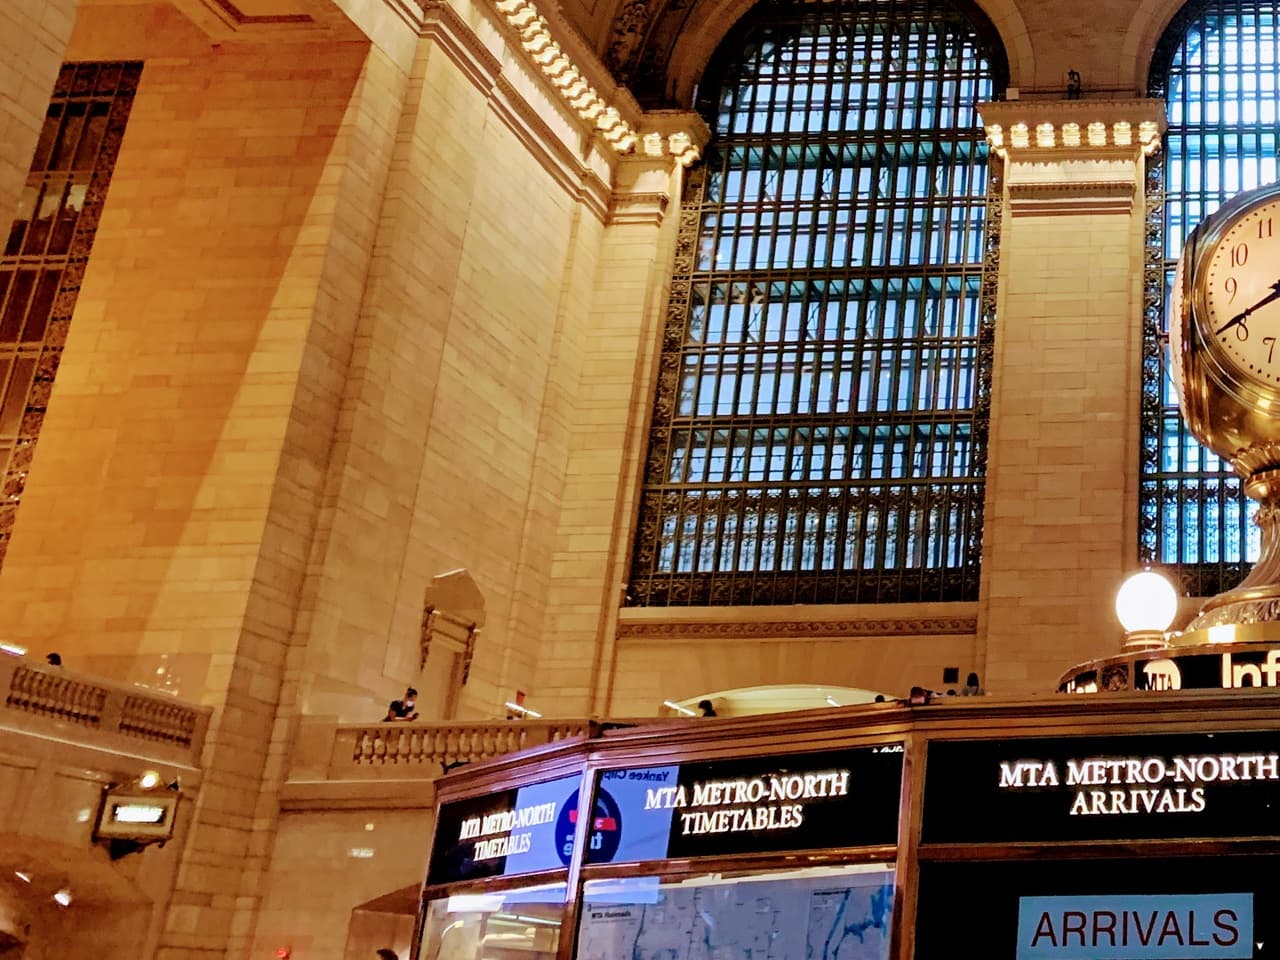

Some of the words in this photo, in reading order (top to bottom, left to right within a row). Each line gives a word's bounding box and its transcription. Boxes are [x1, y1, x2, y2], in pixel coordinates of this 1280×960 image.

[1256, 217, 1273, 239] 11
[1231, 243, 1248, 268] 10
[1225, 277, 1237, 304] 9
[1236, 315, 1249, 341] 8
[1263, 337, 1276, 363] 7
[999, 762, 1059, 787] MTA
[1066, 755, 1279, 785] METRO-NORTH
[644, 784, 687, 810] MTA
[691, 771, 850, 807] METRO-NORTH
[1070, 788, 1205, 815] ARRIVALS
[459, 818, 481, 840] MTA
[481, 802, 557, 836] METRO-NORTH
[681, 805, 803, 835] TIMETABLES
[474, 832, 532, 861] TIMETABLES
[1031, 909, 1239, 947] ARRIVALS
